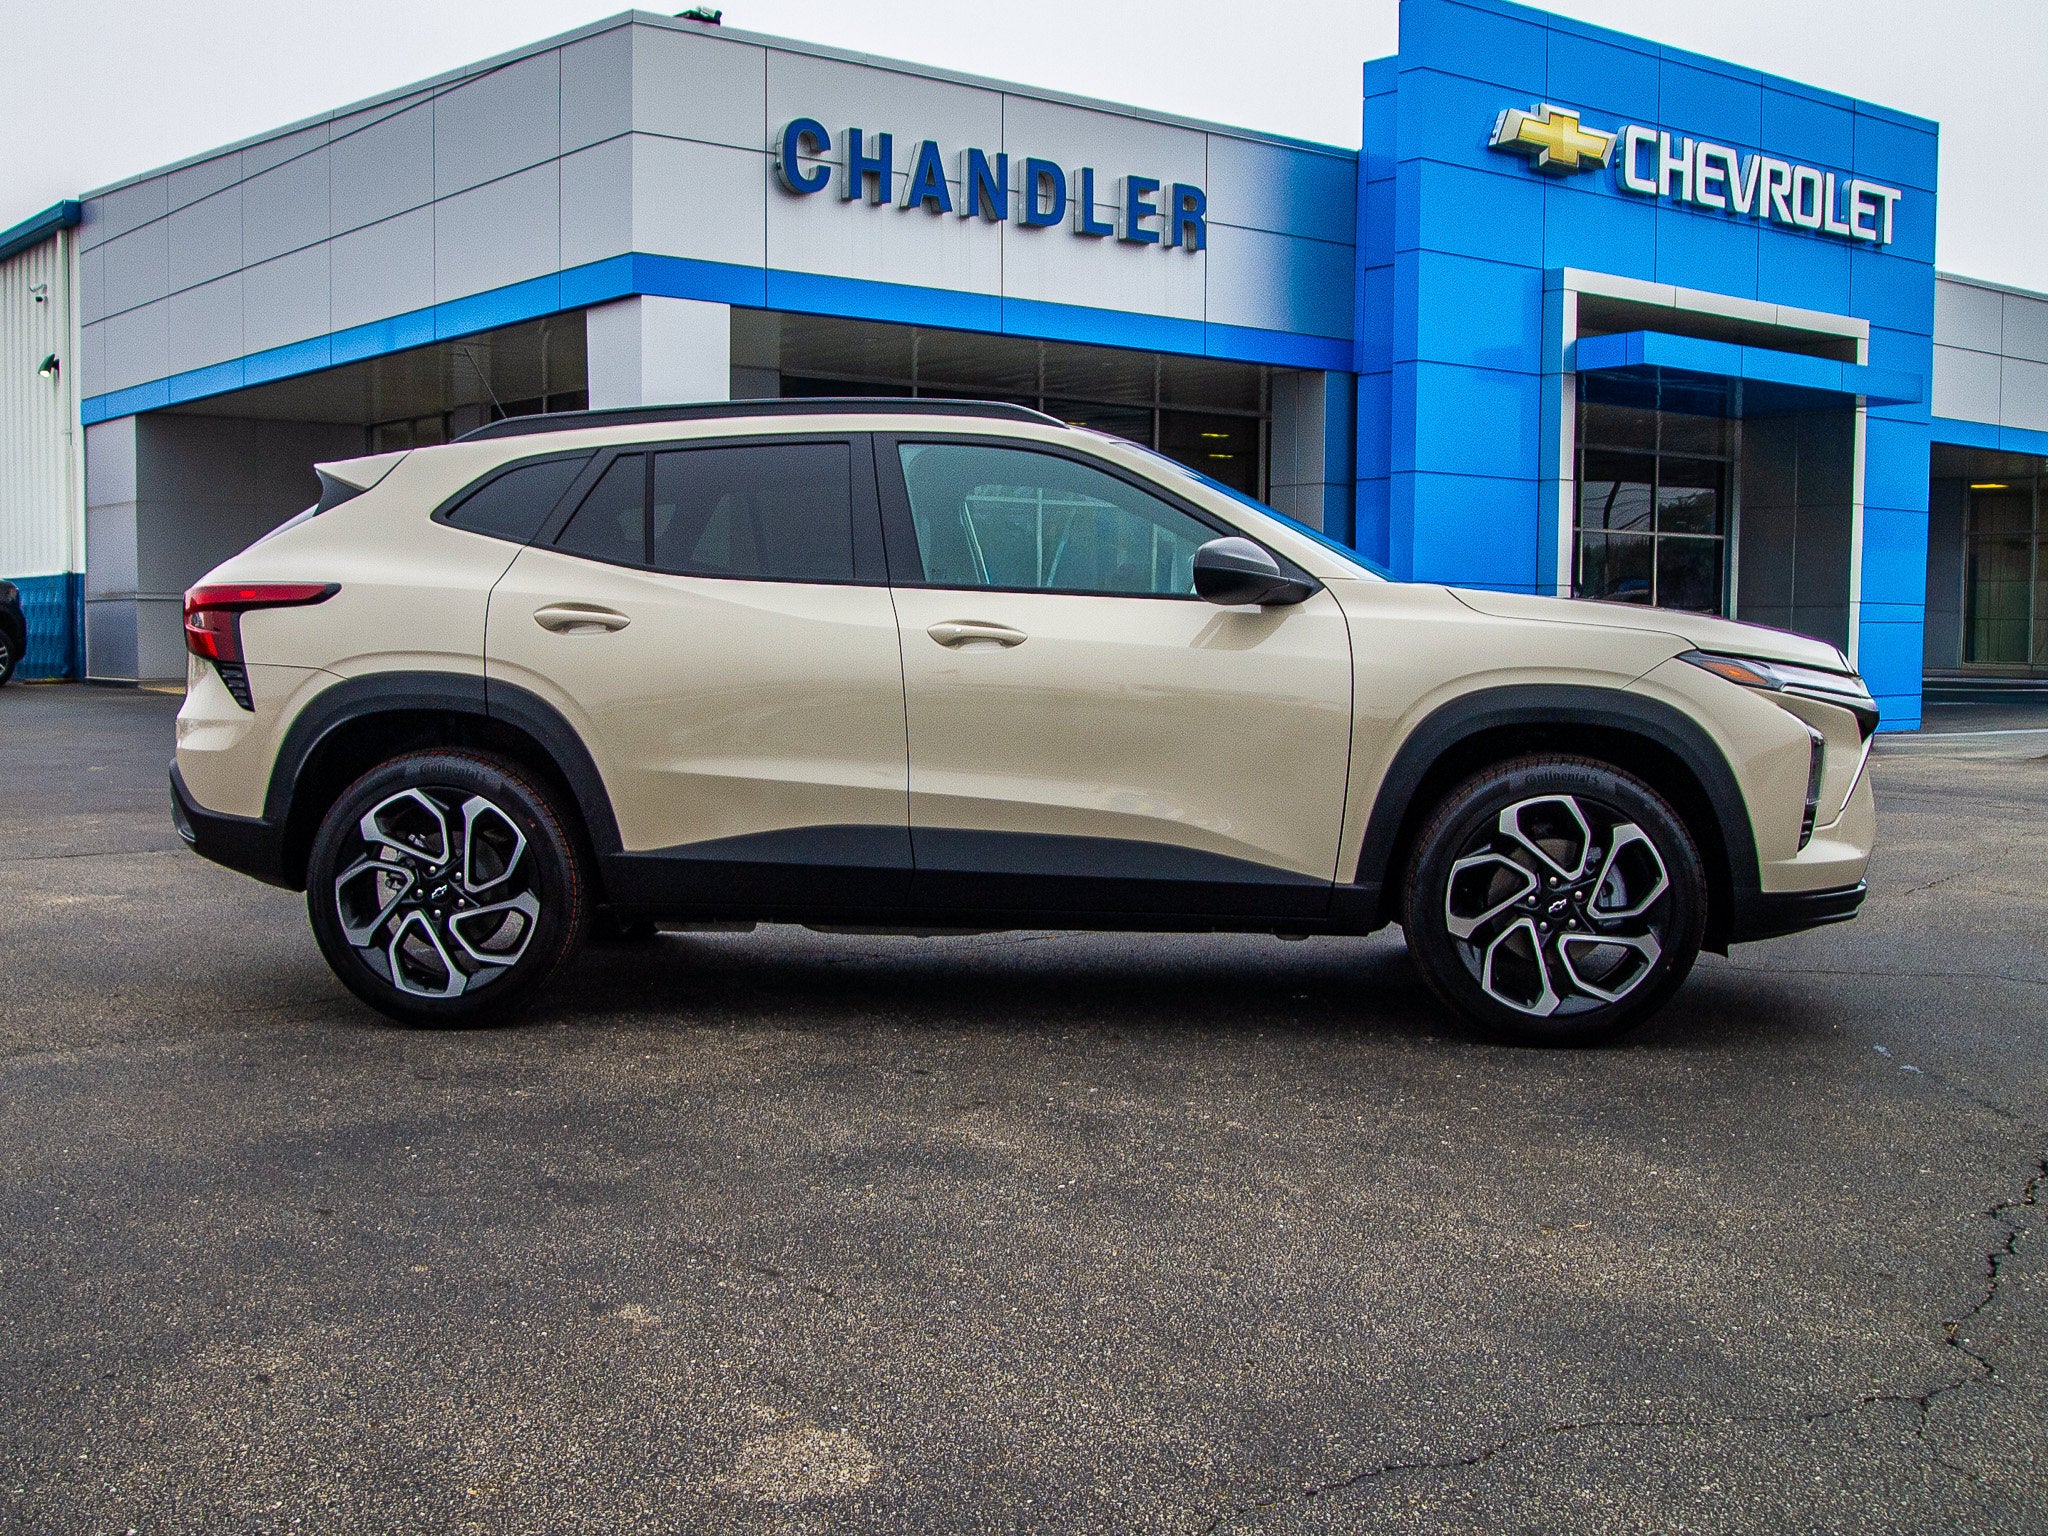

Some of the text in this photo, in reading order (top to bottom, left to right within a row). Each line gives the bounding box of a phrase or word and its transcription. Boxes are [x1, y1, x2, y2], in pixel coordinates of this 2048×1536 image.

[775, 117, 1206, 252] CHANDLER
[1616, 124, 1901, 245] CHEVROLET
[1525, 771, 1591, 783] Continental
